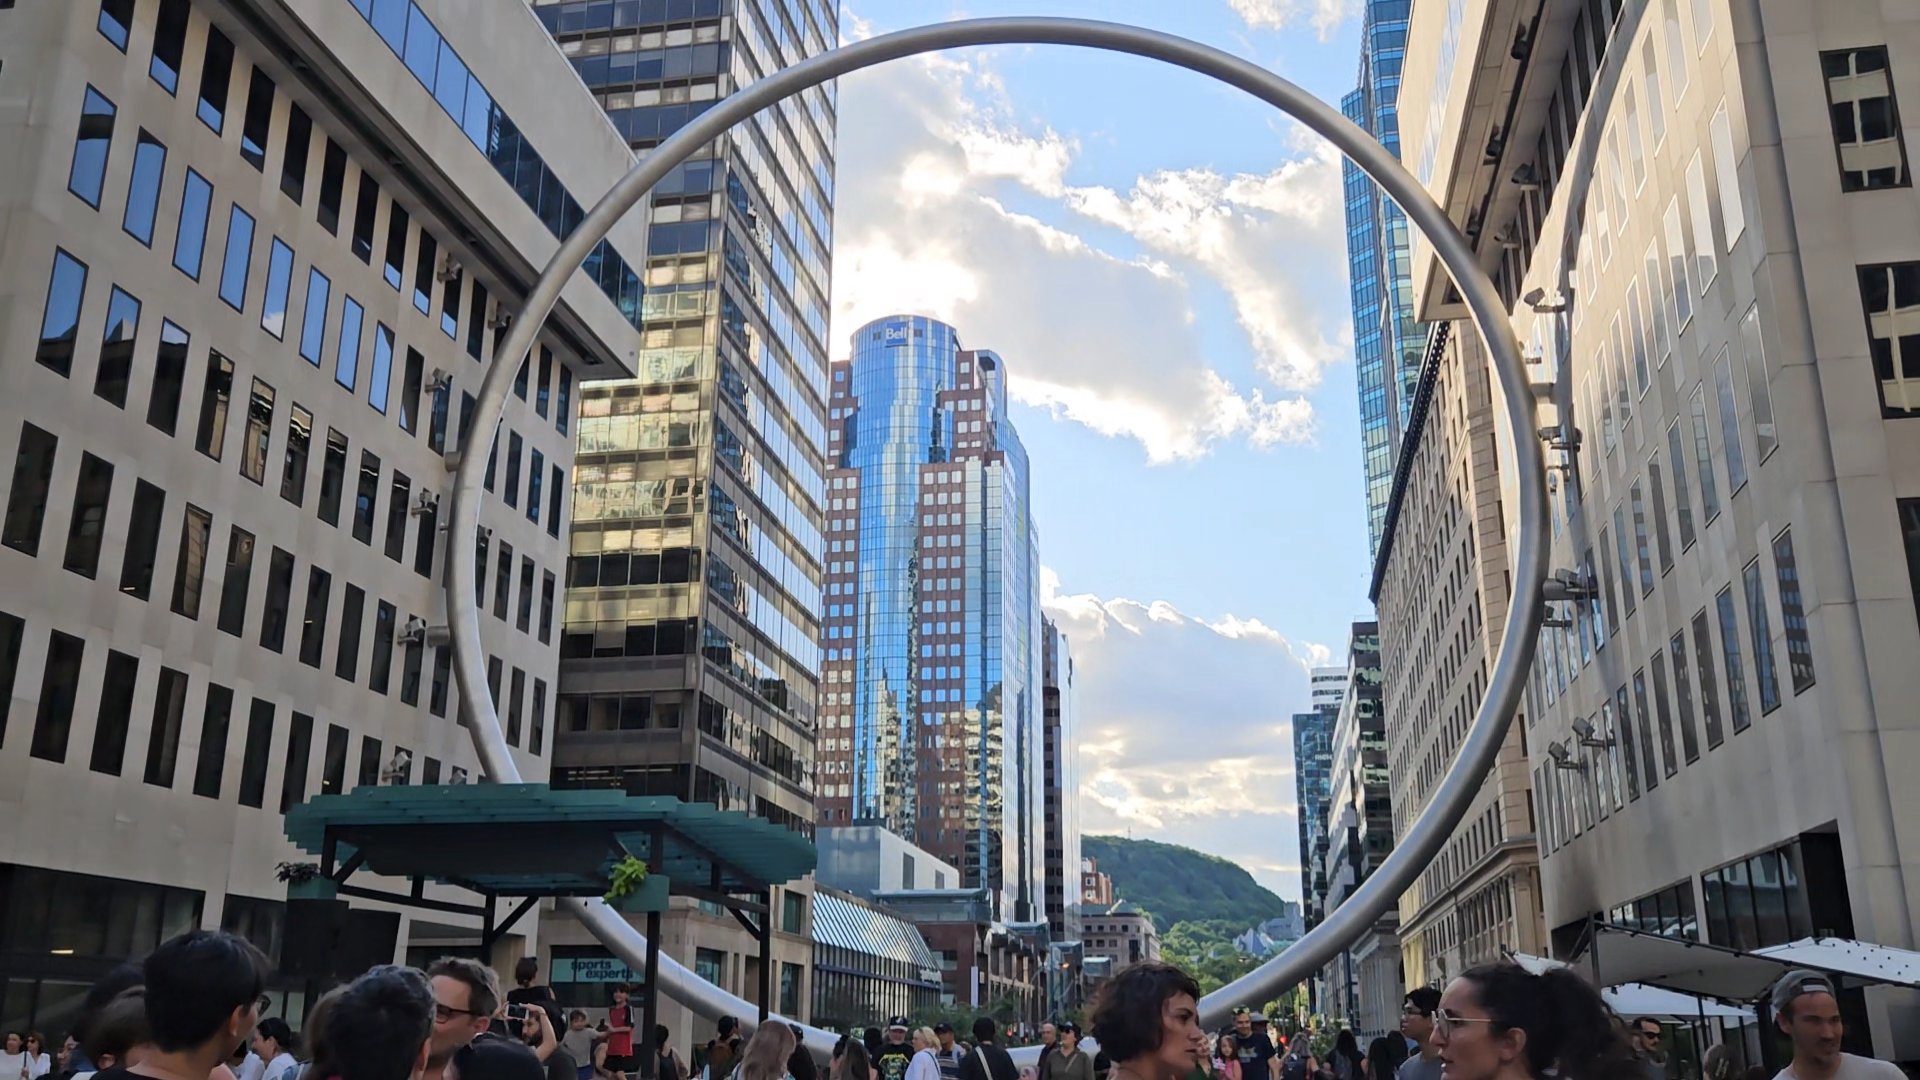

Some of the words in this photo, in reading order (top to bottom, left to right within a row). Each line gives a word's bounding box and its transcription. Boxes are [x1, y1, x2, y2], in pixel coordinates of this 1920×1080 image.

[886, 327, 907, 340] Bell
[571, 960, 612, 972] sports
[585, 968, 633, 980] experts
